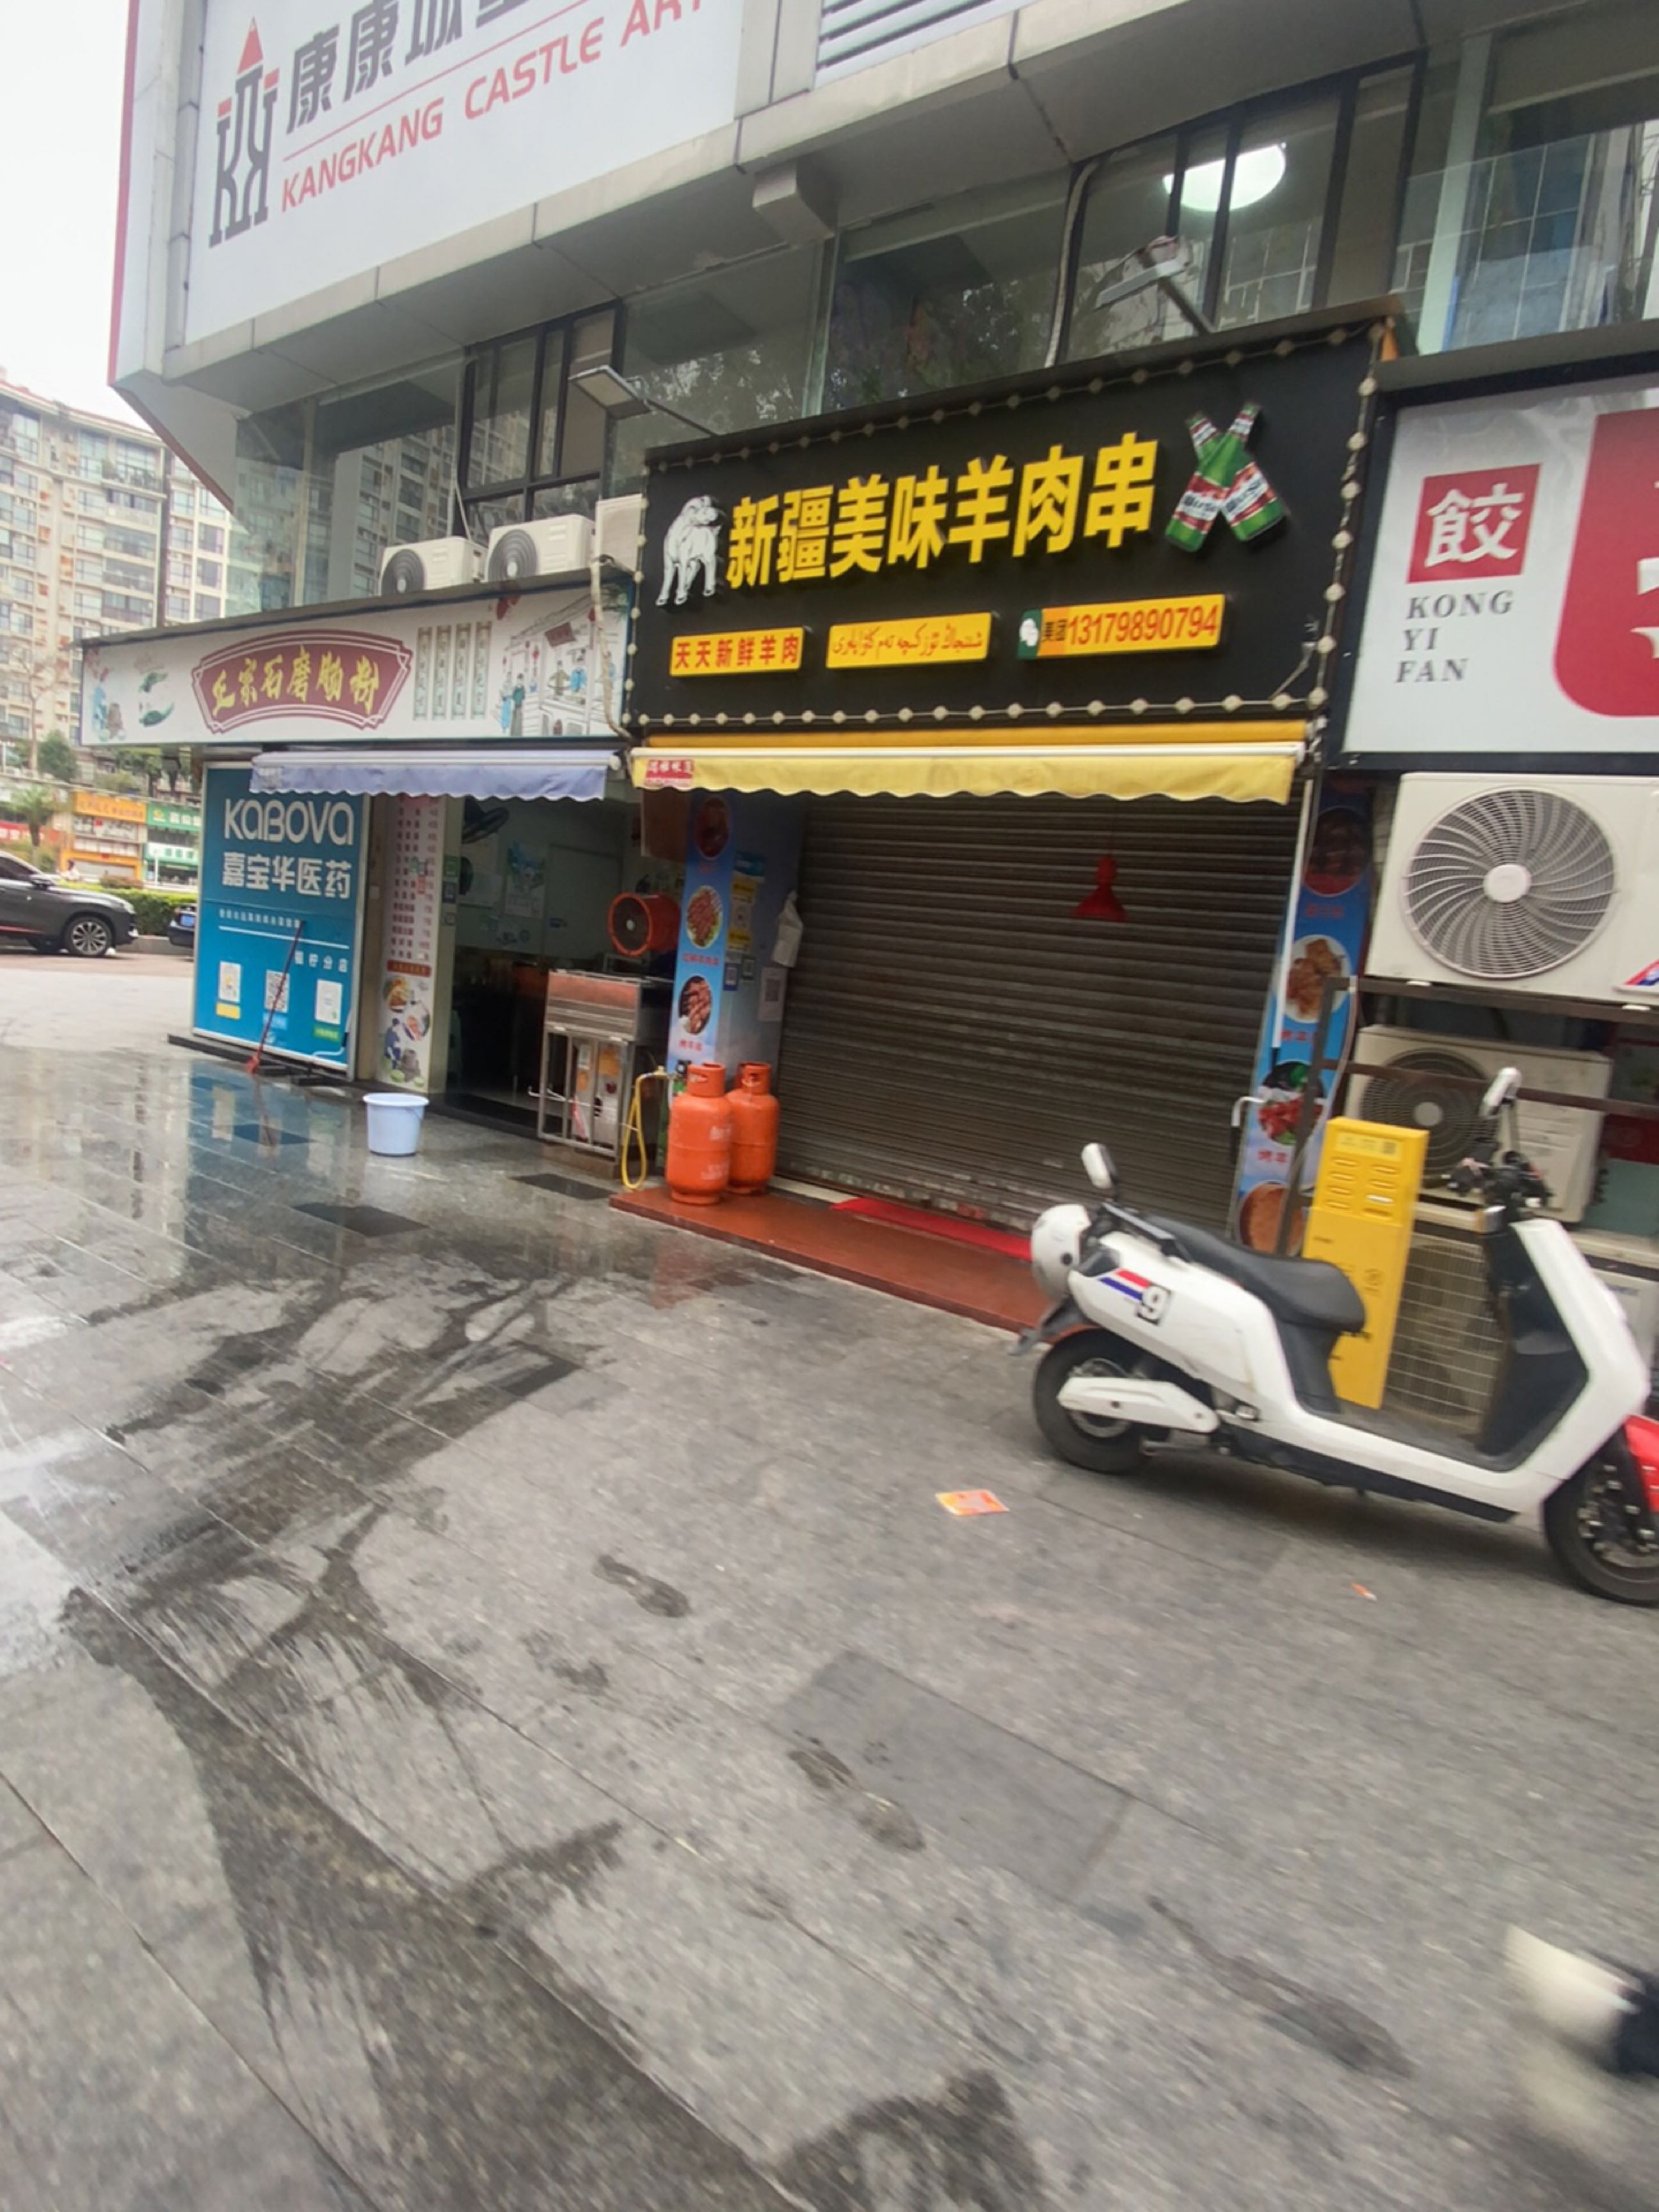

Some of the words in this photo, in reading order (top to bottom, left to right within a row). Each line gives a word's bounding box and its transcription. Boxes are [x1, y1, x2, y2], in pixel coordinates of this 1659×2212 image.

[282, 98, 445, 212] KANGKANG
[465, 18, 604, 120] CASTLE
[725, 432, 1158, 589] 新疆美味羊肉串
[1425, 483, 1525, 567] 餃
[1068, 604, 1219, 646] 13179890794
[1406, 590, 1515, 620] KONG
[675, 636, 800, 669] 天天新鲜羊肉
[1404, 627, 1439, 652] YI
[1395, 658, 1470, 684] FAN
[221, 851, 351, 899] 嘉宝华医药
